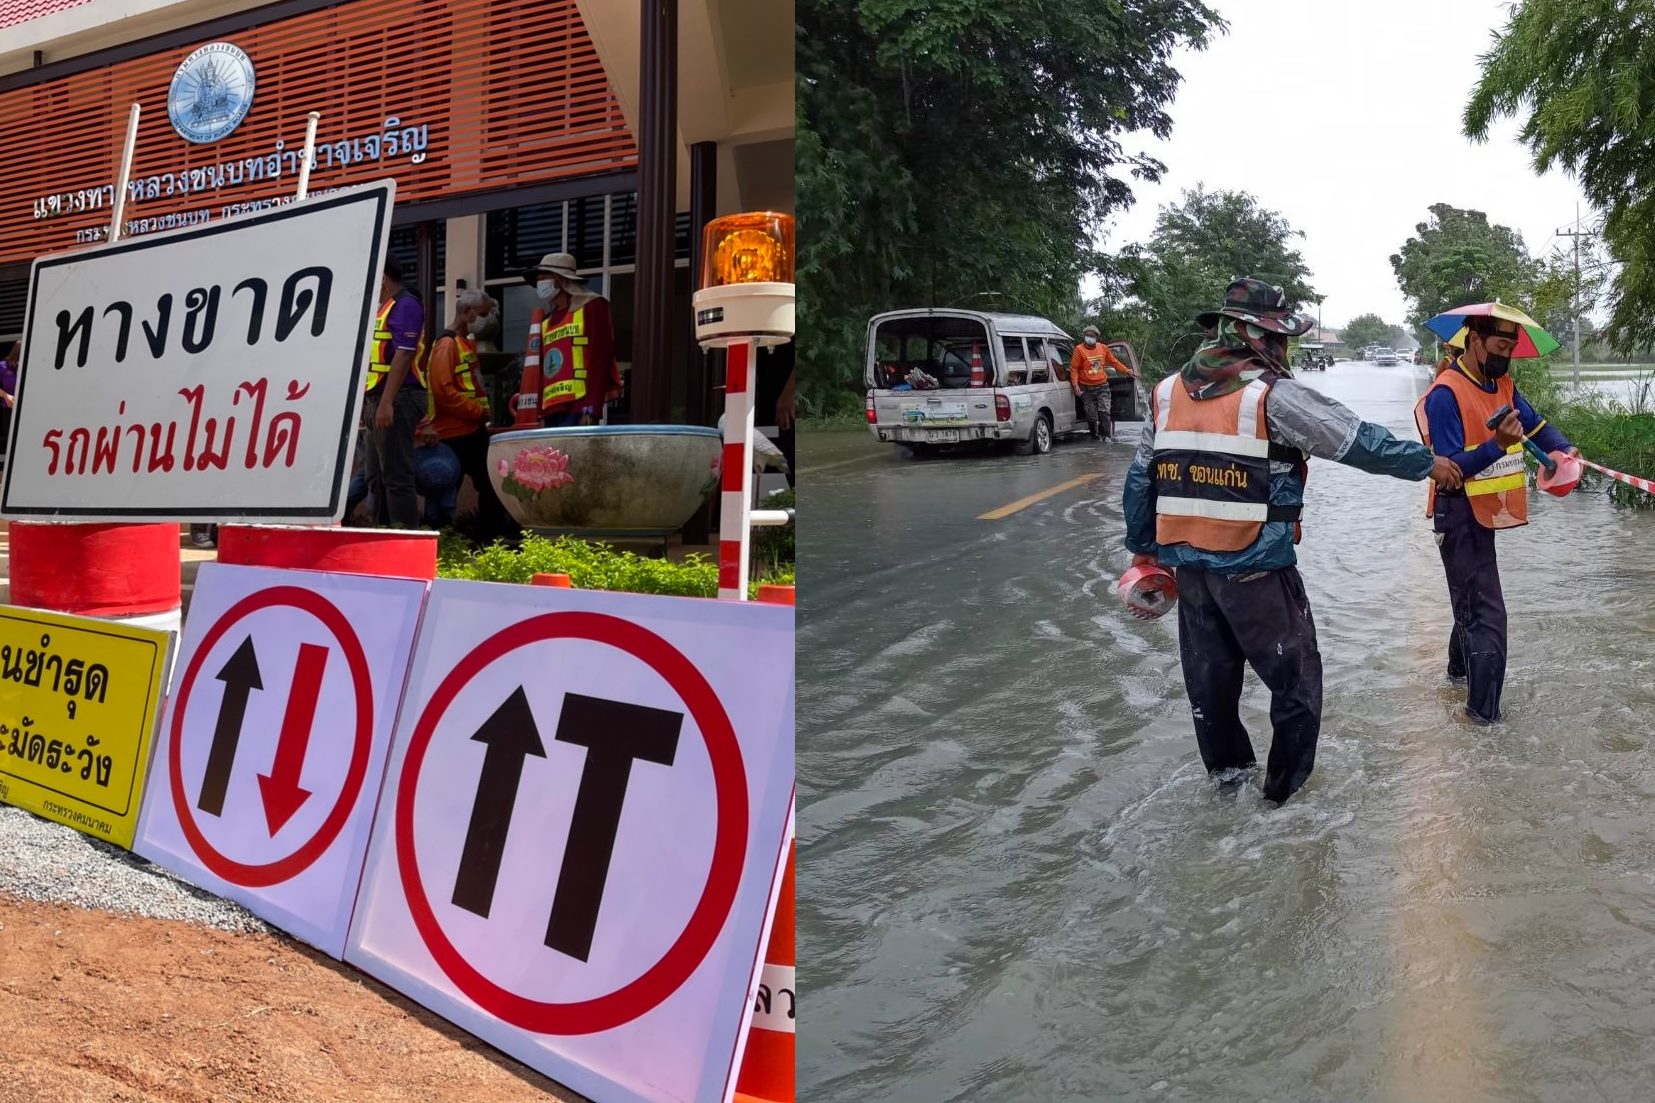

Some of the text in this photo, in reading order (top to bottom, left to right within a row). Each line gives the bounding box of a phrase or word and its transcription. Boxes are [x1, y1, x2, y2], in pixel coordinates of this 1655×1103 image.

[33, 116, 429, 219] แขวงทาหลวงชนบทอำนาจเจริญ
[54, 266, 334, 370] ทางขาด
[42, 377, 311, 475] รถผ่านไม่ได้
[1189, 463, 1248, 488] ขอนแก่น
[43, 800, 112, 835] กระทรวงคมนาคม
